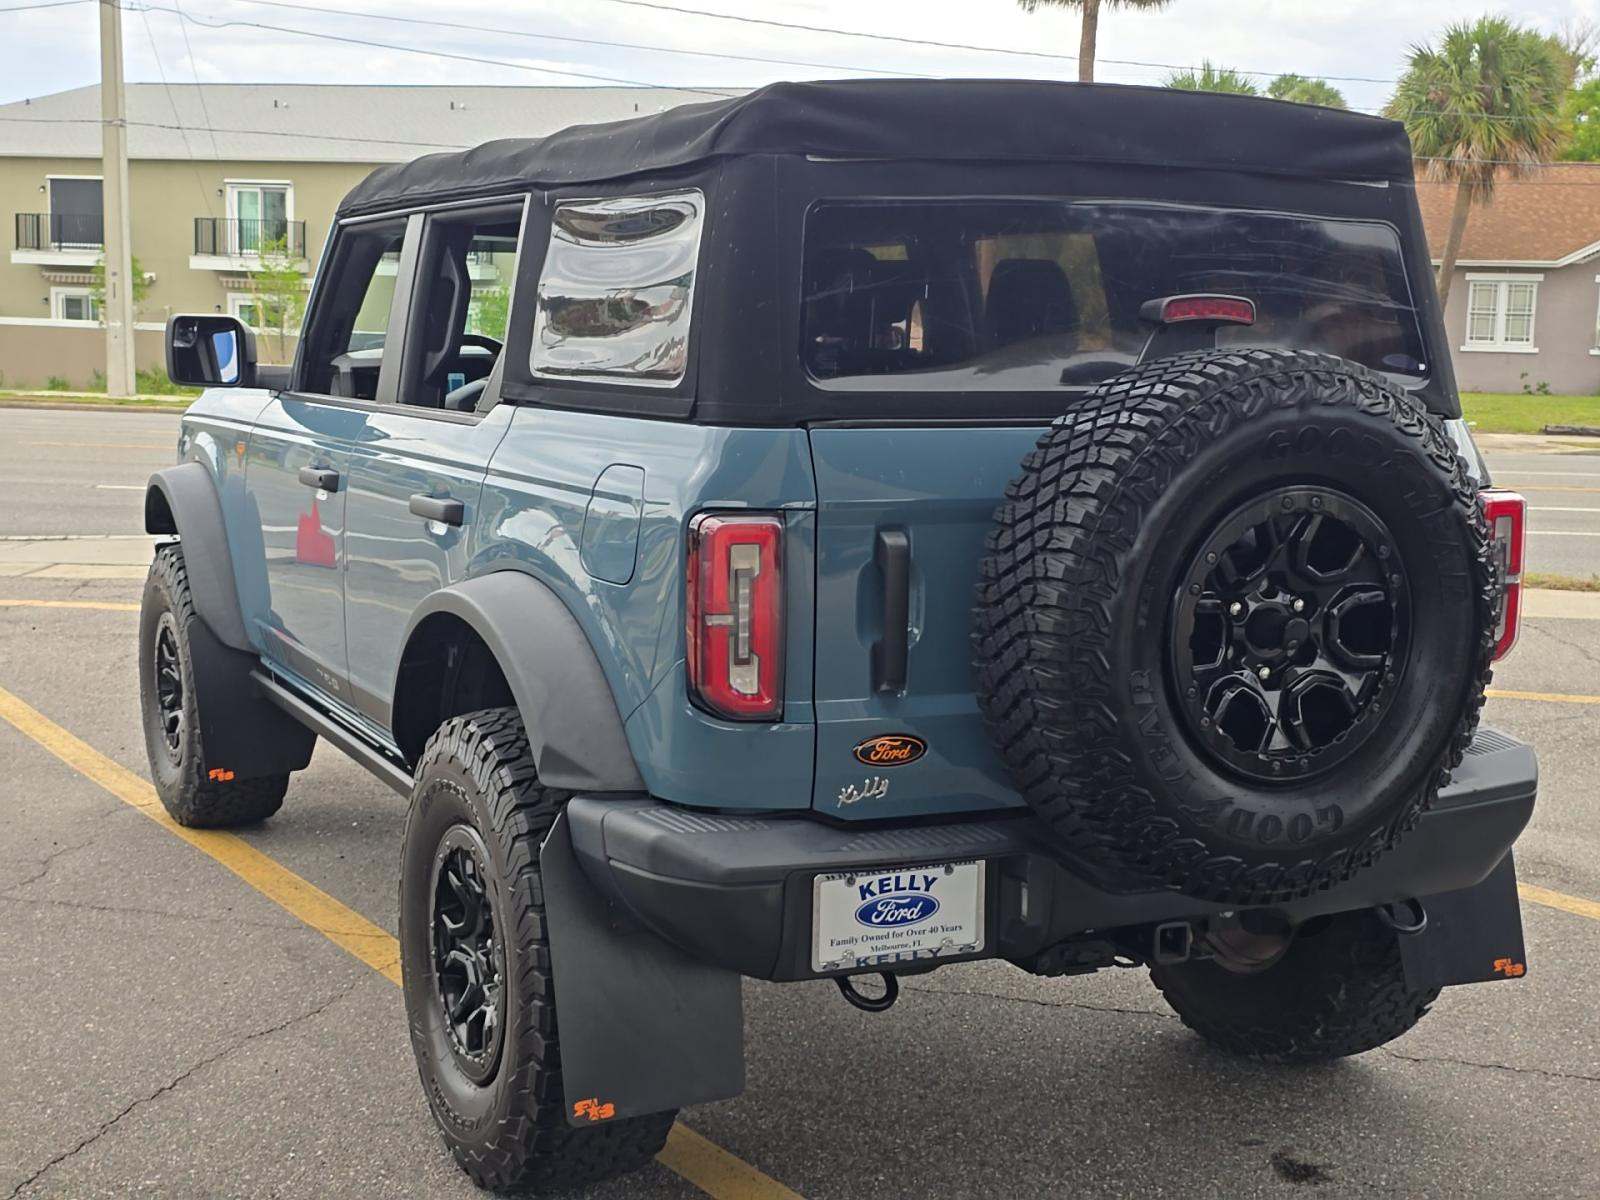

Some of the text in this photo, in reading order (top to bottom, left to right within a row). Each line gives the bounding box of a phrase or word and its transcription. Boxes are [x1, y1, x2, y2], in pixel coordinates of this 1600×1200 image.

[837, 776, 889, 808] Kelly
[858, 874, 938, 901] KELLY
[871, 897, 923, 924] Ford
[830, 924, 963, 947] Family Owned for Over 40 Years
[870, 941, 912, 953] Melbourne,
